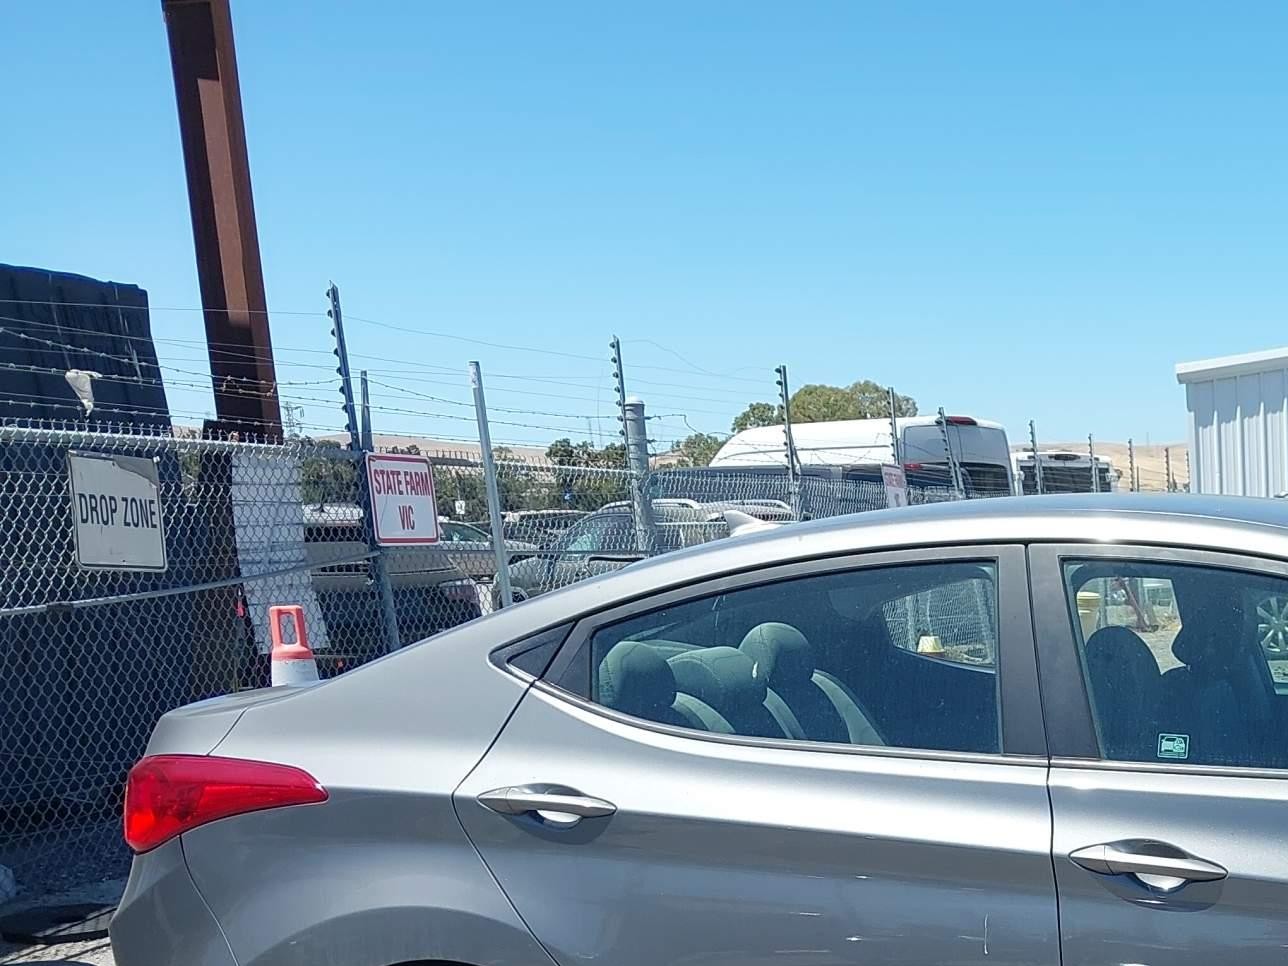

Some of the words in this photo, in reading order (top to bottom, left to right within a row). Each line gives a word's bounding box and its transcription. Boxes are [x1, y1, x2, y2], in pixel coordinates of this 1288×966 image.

[374, 469, 403, 495] STATE
[404, 470, 431, 496] FARM
[78, 493, 118, 526] DROP
[121, 496, 158, 528] ZONE
[398, 505, 415, 530] VIC
